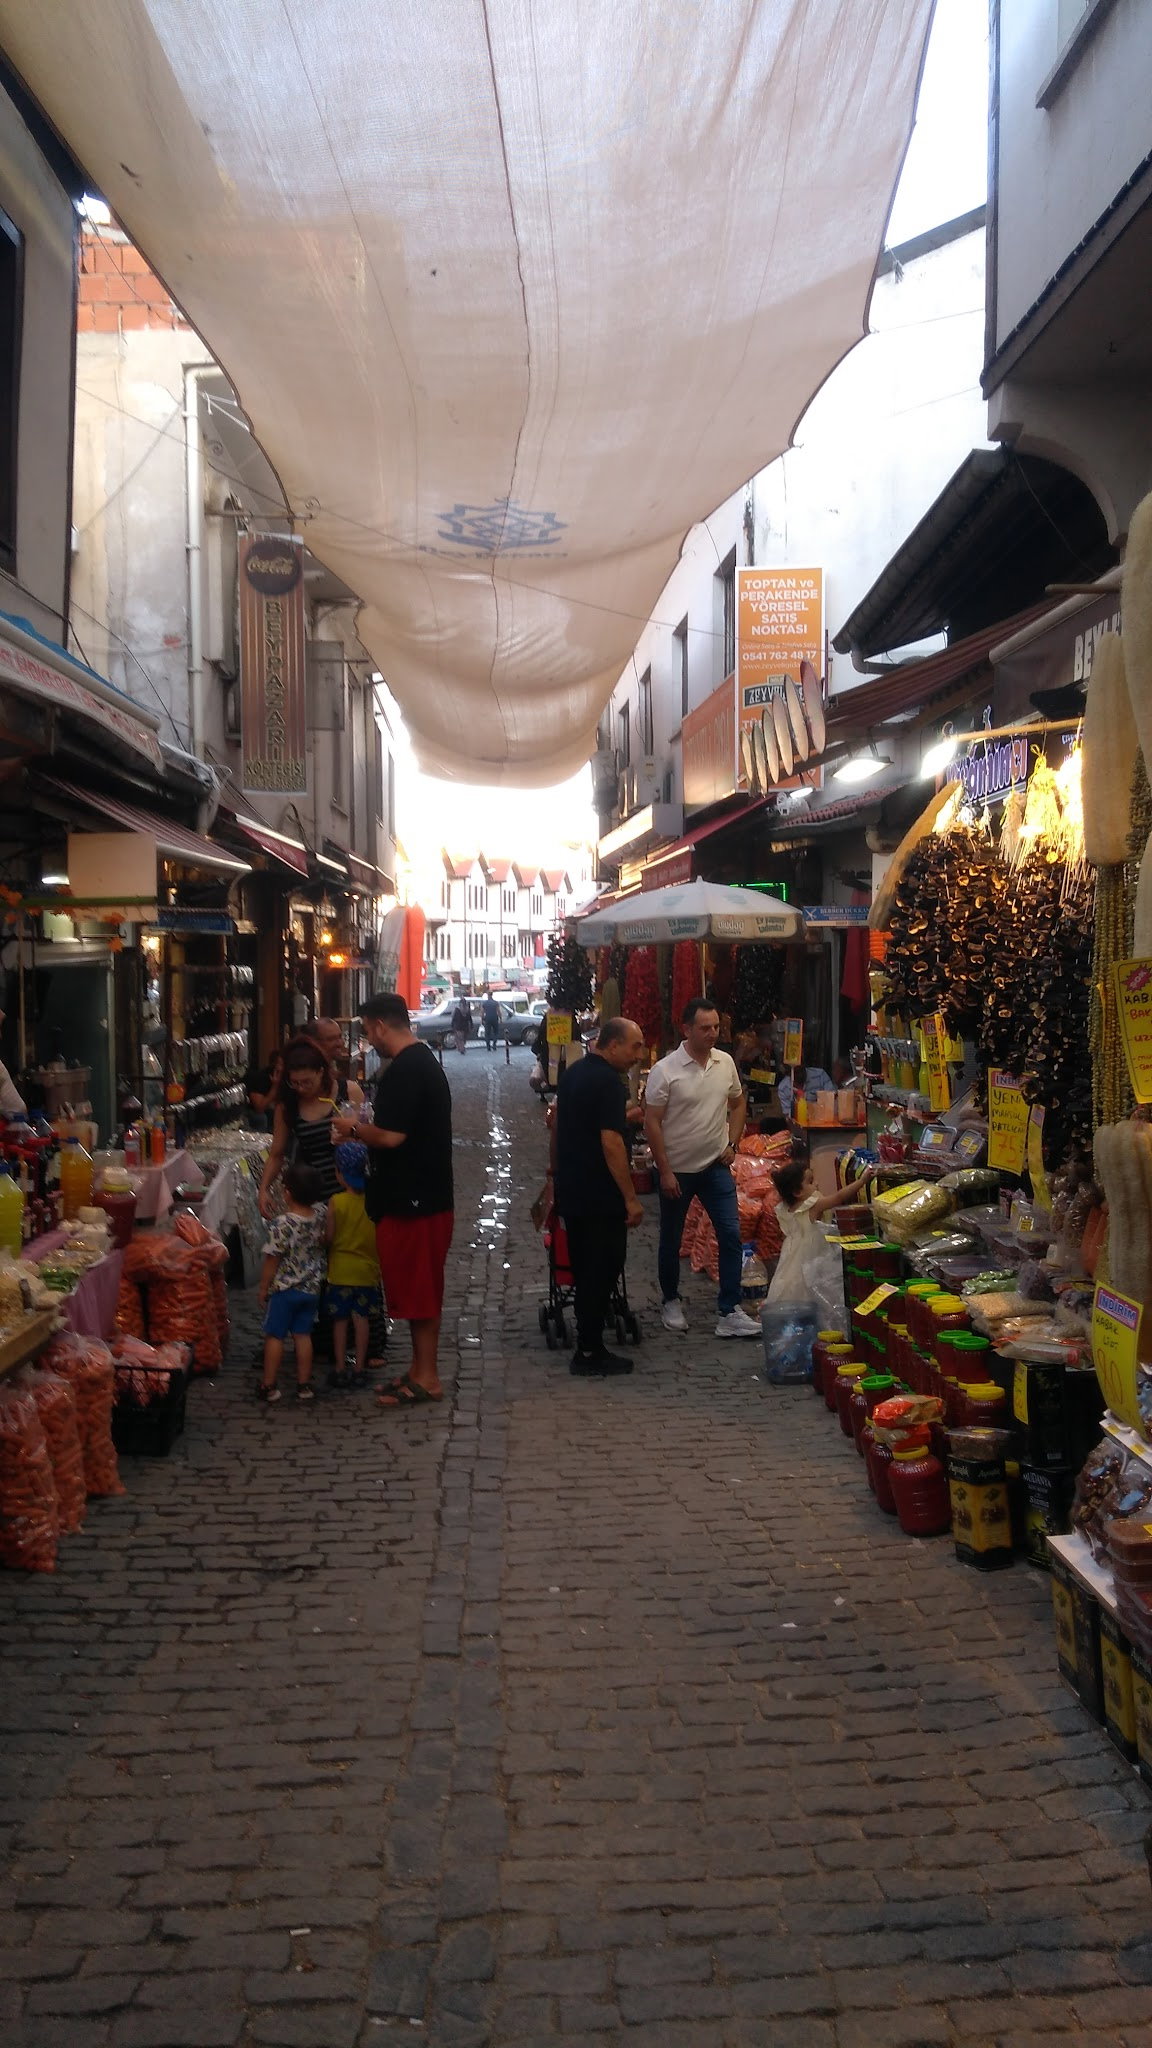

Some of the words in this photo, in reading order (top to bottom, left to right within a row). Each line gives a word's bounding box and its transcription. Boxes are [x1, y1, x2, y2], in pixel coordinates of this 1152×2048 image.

[744, 578, 796, 589] TOPTAN
[800, 579, 814, 588] ve
[740, 589, 818, 601] PERAKENDE
[750, 599, 809, 612] YÖRESEL
[761, 613, 797, 624] SATIŞ
[751, 624, 808, 635] NOKTASI
[742, 652, 766, 661] 0541
[769, 651, 788, 660] 762
[790, 651, 803, 660] 48
[806, 650, 817, 659] 17
[265, 600, 285, 761] BEYPAZARI
[1124, 993, 1152, 1004] KAB
